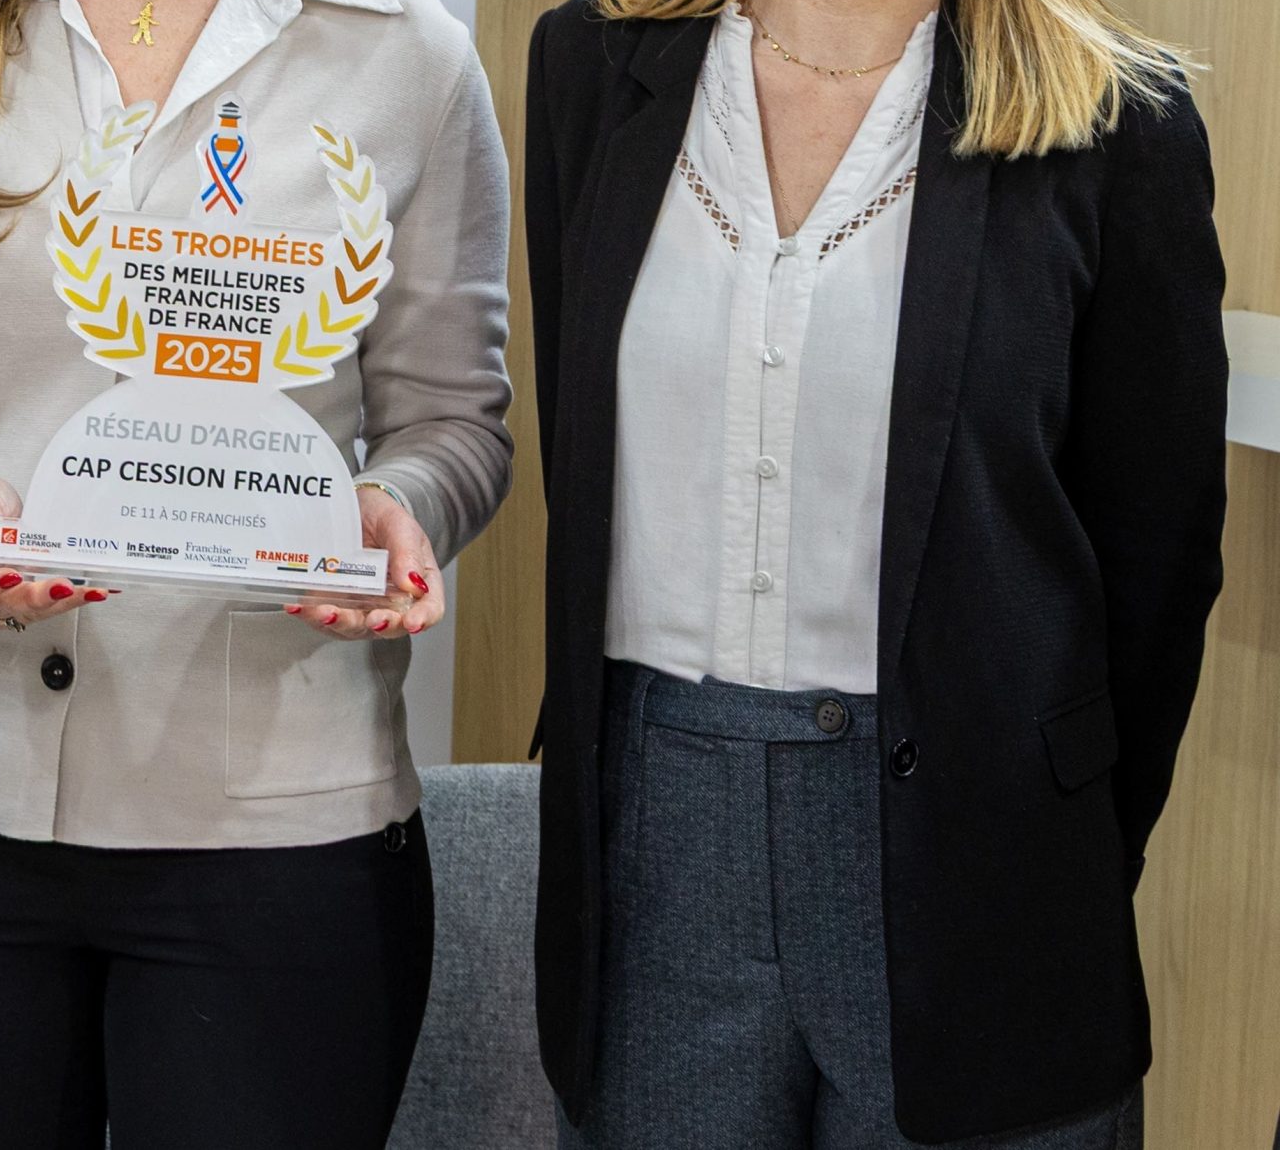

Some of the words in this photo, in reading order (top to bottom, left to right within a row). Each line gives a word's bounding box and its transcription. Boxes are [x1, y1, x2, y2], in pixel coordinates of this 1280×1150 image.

[111, 225, 163, 253] LES
[171, 230, 325, 267] TROPHÉES
[123, 262, 165, 282] DES
[172, 266, 305, 294] MEILLEURES
[144, 286, 280, 314] FRANCHISES
[148, 308, 177, 327] DE
[184, 312, 272, 335] FRANCE
[162, 339, 253, 376] 2025
[85, 412, 182, 444] RÉSEAU
[190, 424, 318, 455] D’ARGENT
[61, 455, 112, 479] CAP
[119, 460, 225, 489] CESSION
[234, 470, 333, 498] FRANCE
[120, 505, 137, 518] DE
[141, 507, 155, 519] 11
[159, 506, 168, 520] À
[172, 510, 187, 522] 50
[190, 510, 267, 529] FRANCHISÉS
[20, 532, 48, 541] CAISSE
[67, 537, 119, 550] SIMON
[127, 542, 136, 552] In
[138, 543, 179, 555] Extenso
[185, 541, 232, 554] Franchise
[184, 553, 250, 565] MANAGEMENT
[255, 550, 309, 564] FRANCHISE
